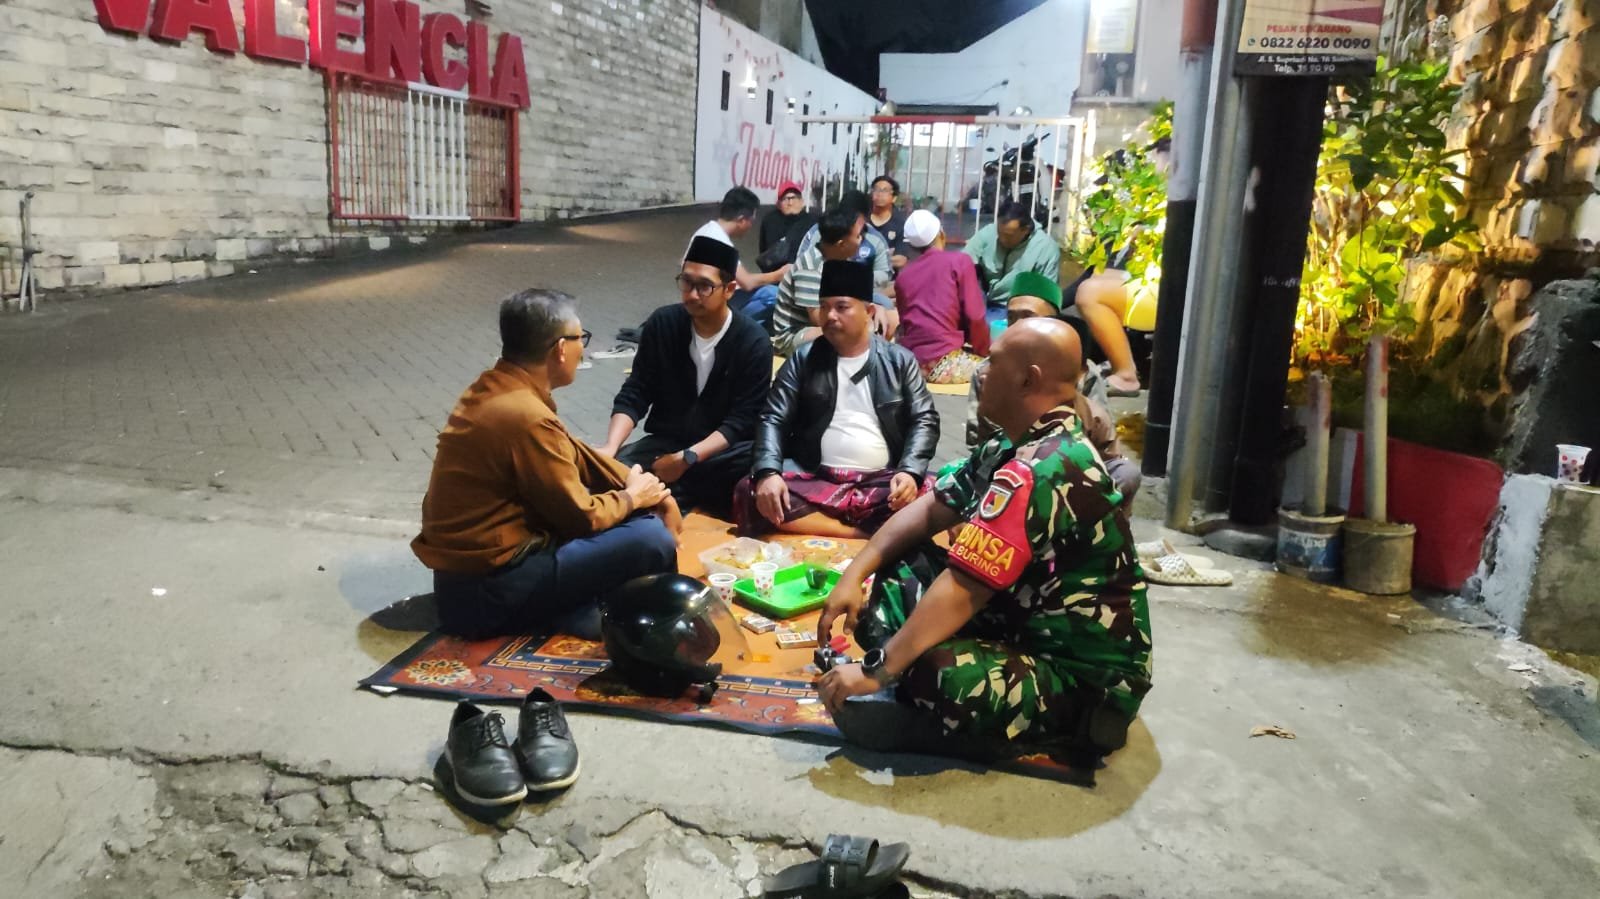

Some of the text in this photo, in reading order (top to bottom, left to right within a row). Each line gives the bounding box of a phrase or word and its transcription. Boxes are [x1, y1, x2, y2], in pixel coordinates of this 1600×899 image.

[1266, 24, 1297, 34] PESAN
[1260, 37, 1371, 49] 0822 6220 0090
[955, 545, 1001, 577] BURING
